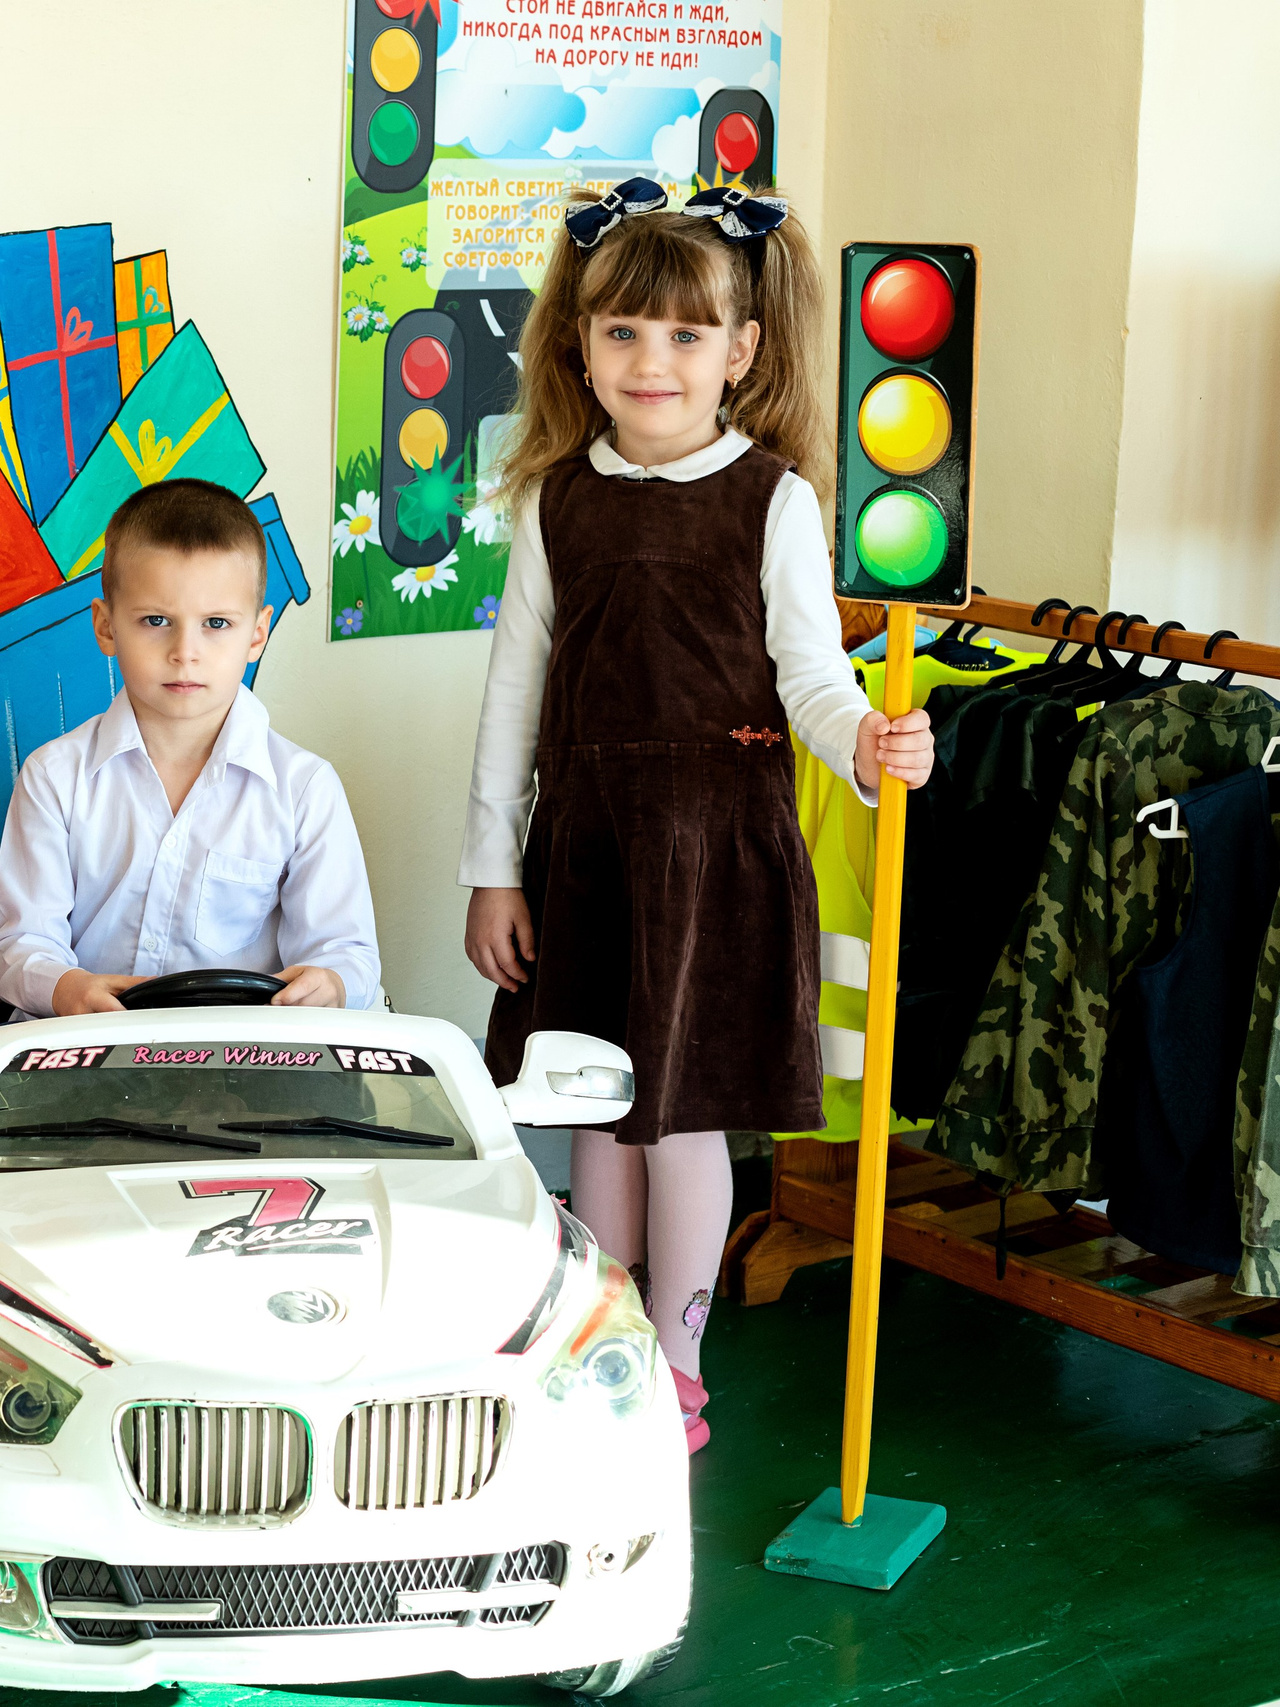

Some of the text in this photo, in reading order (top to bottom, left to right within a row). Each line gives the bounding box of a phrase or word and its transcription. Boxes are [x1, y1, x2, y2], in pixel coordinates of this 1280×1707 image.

[556, 0, 576, 15] НЕ
[581, 0, 667, 19] ДВИГАЙСЯ
[674, 4, 683, 19] И
[689, 5, 730, 24] ЖДИ,
[462, 21, 763, 49] НИКОГДА ПОД КРАСНЫМ ВЗГЛЯДОМ
[535, 48, 699, 70] НА ДОРОГУ НЕ ИДИ!
[430, 178, 499, 197] ЖЕЛТЫЙ
[505, 181, 564, 197] СВЕТИТ
[446, 205, 525, 220] ГОВОРИТ:
[452, 228, 545, 244] ЗАГОРИТСЯ
[443, 251, 546, 268] СФЕТОФОРА
[20, 1045, 414, 1074] FAST Racer Winner FAST
[178, 1176, 326, 1227] 7
[203, 1220, 364, 1251] Racer
